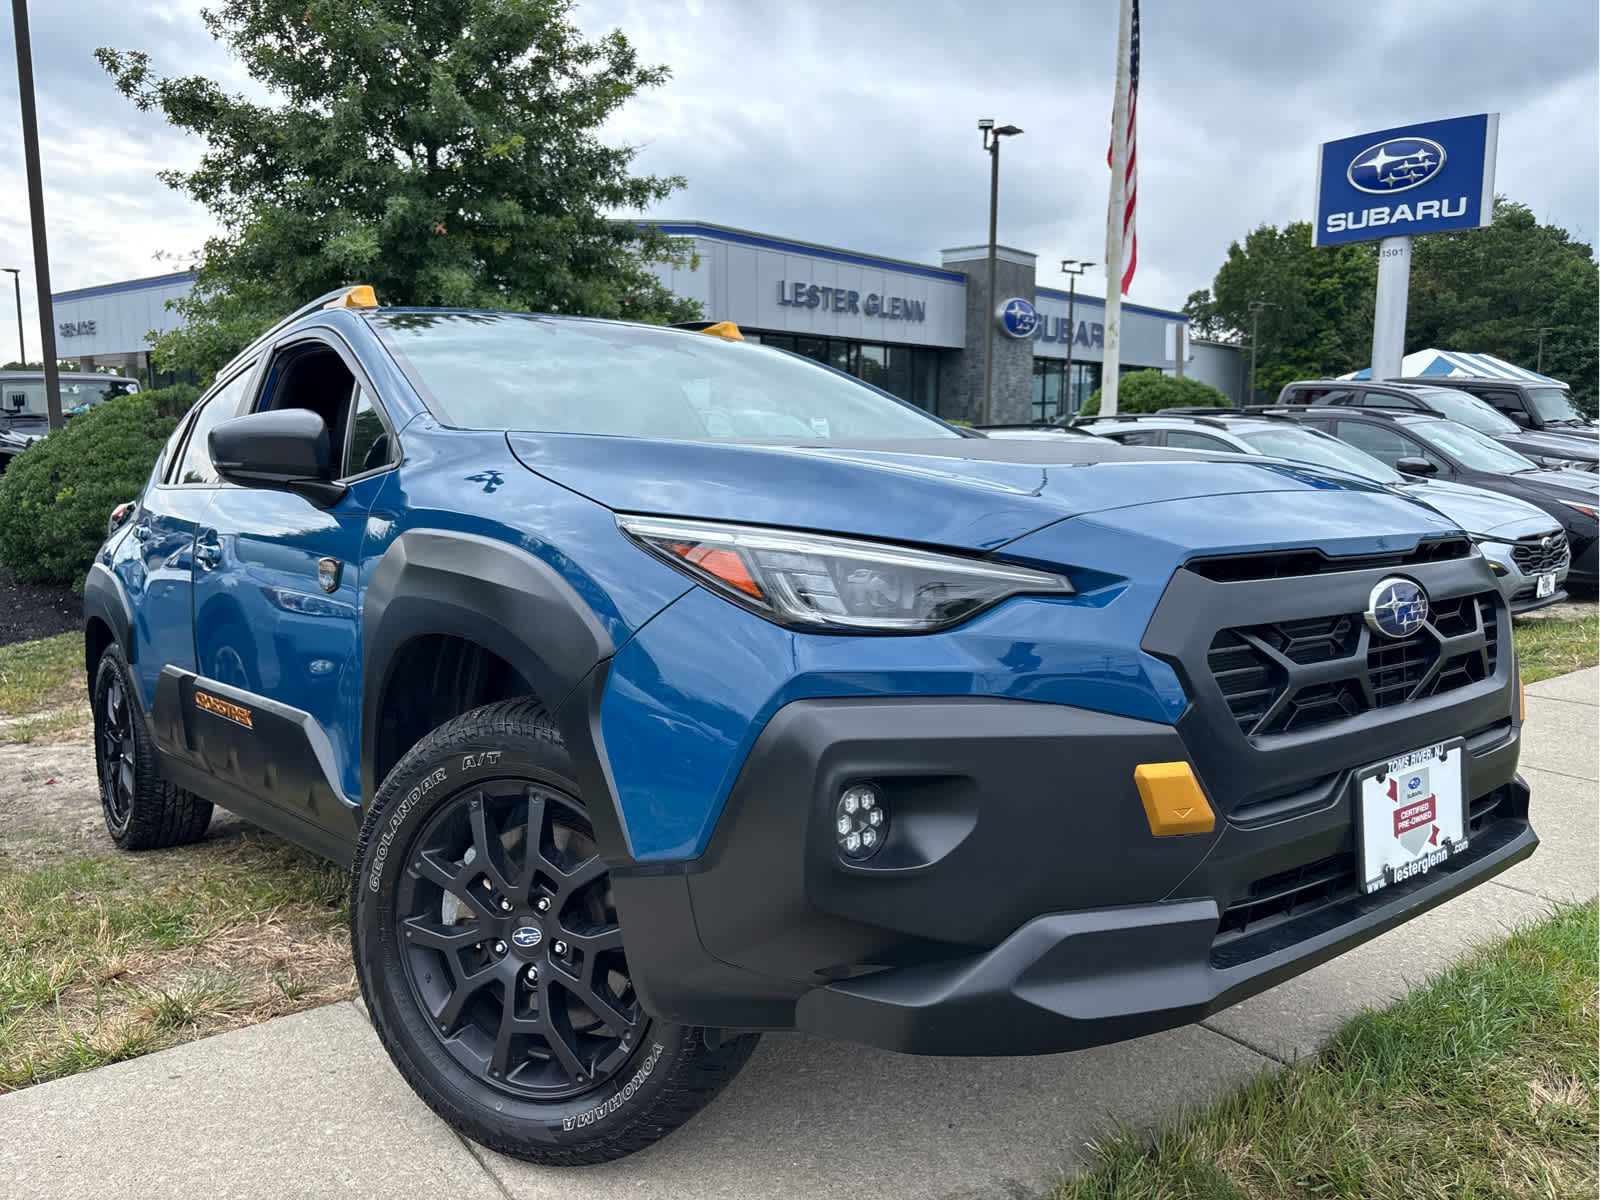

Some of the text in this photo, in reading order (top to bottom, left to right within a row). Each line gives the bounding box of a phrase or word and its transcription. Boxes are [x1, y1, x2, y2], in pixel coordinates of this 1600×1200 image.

[1326, 197, 1467, 233] SUBARU
[1382, 248, 1403, 258] 1501
[777, 280, 926, 323] LESTER GLENN
[1032, 313, 1104, 348] SUBAR
[462, 751, 502, 770] A/T
[1388, 757, 1409, 773] TOMS
[1398, 810, 1432, 830] PRE-OWNED
[1400, 802, 1429, 820] CERTIFIED
[369, 767, 448, 892] GEOLANDAR
[563, 1042, 664, 1131] YOKOHAMA
